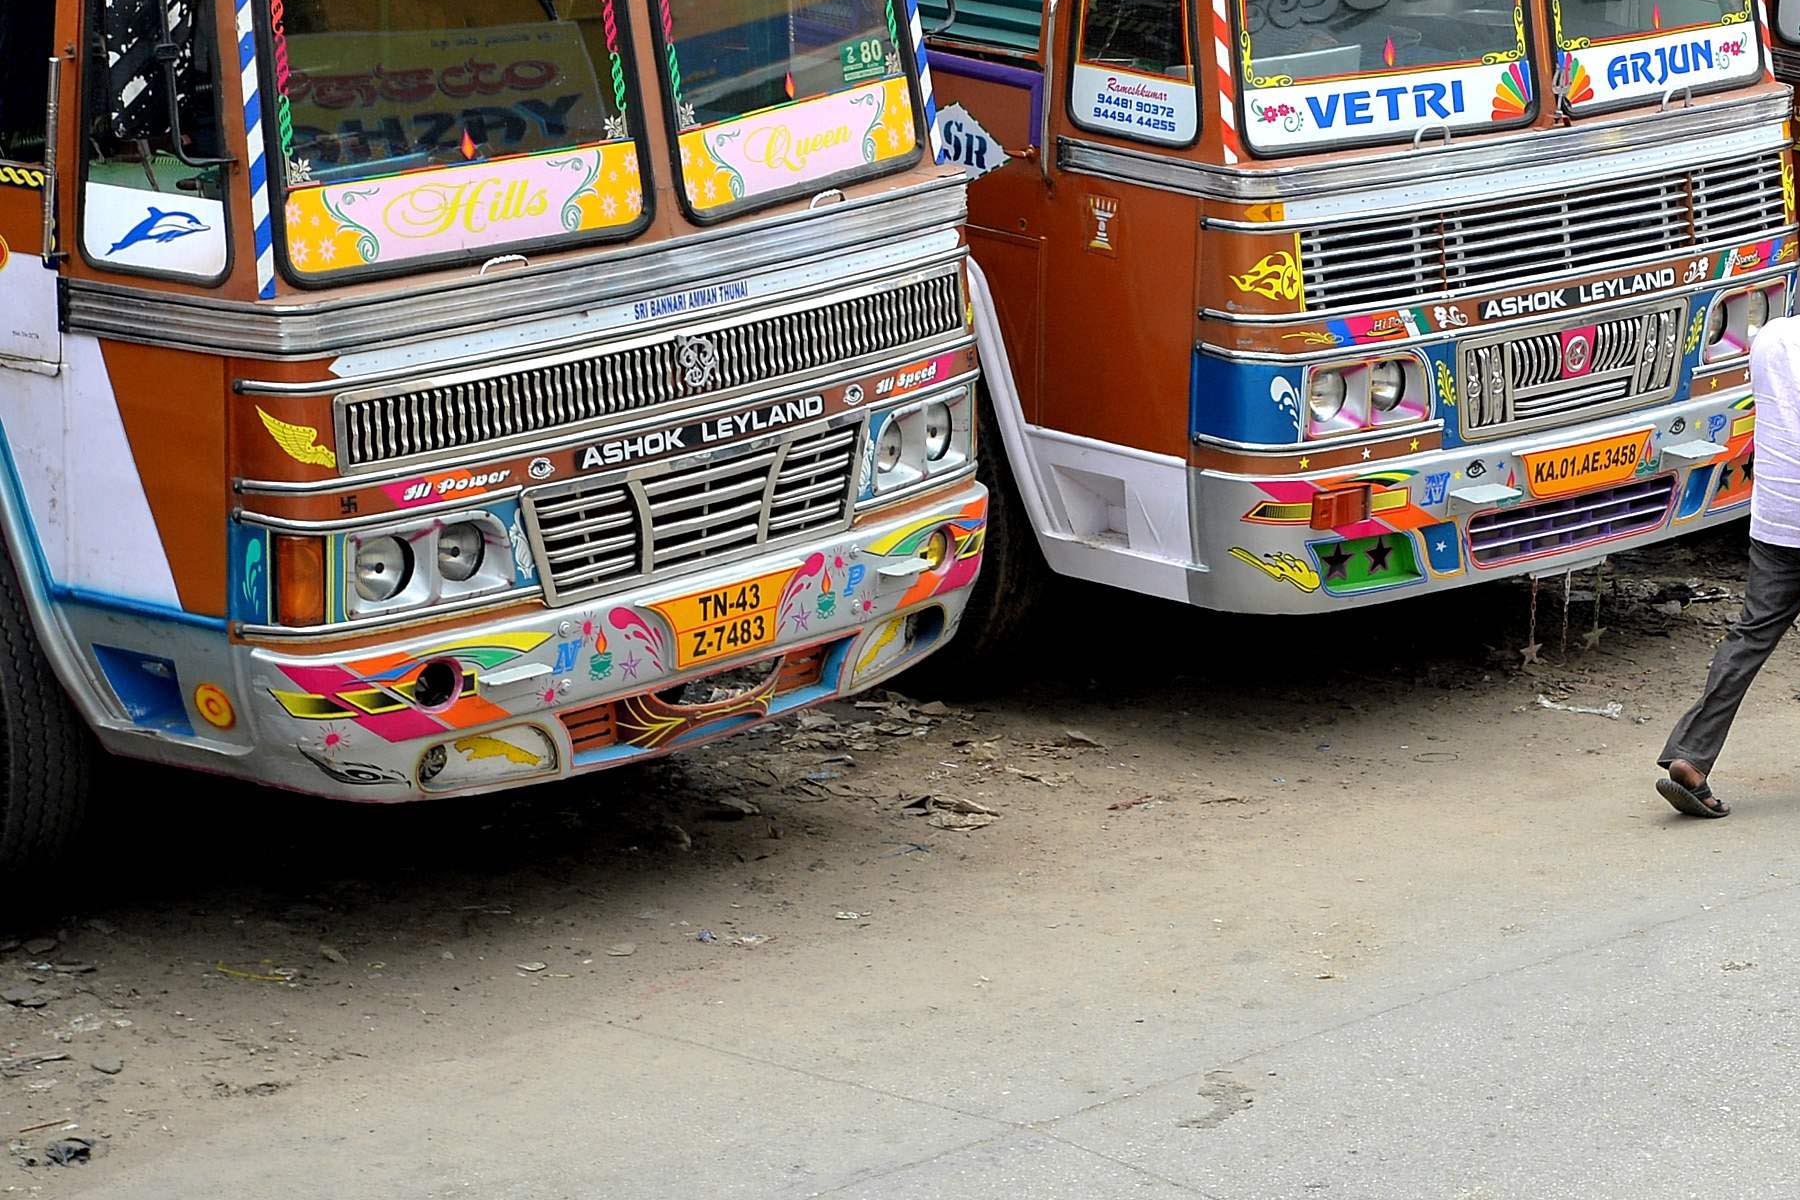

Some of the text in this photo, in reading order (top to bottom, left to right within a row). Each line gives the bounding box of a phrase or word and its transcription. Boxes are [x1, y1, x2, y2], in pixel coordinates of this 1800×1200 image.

[860, 39, 882, 63] 80
[1607, 40, 1715, 89] ARJUN
[1097, 93, 1175, 118] 94481 90372
[1107, 77, 1168, 101] Rameshkumar
[1305, 80, 1467, 130] VETRI
[1093, 107, 1176, 132] 94494 44255
[742, 119, 853, 174] Queen
[943, 120, 988, 170] SR
[381, 175, 552, 240] Hills
[634, 280, 749, 321] SRI BANNARI AMMAN THUNAI
[1484, 268, 1676, 320] ASHOK LEYLAND
[896, 361, 939, 393] Speed
[581, 394, 826, 471] ASHOK LEYLAND
[1534, 442, 1637, 484] KA.01.AE.3458
[403, 467, 512, 504] Hi Power
[698, 582, 762, 621] TN-43
[692, 615, 768, 660] Z-7483
